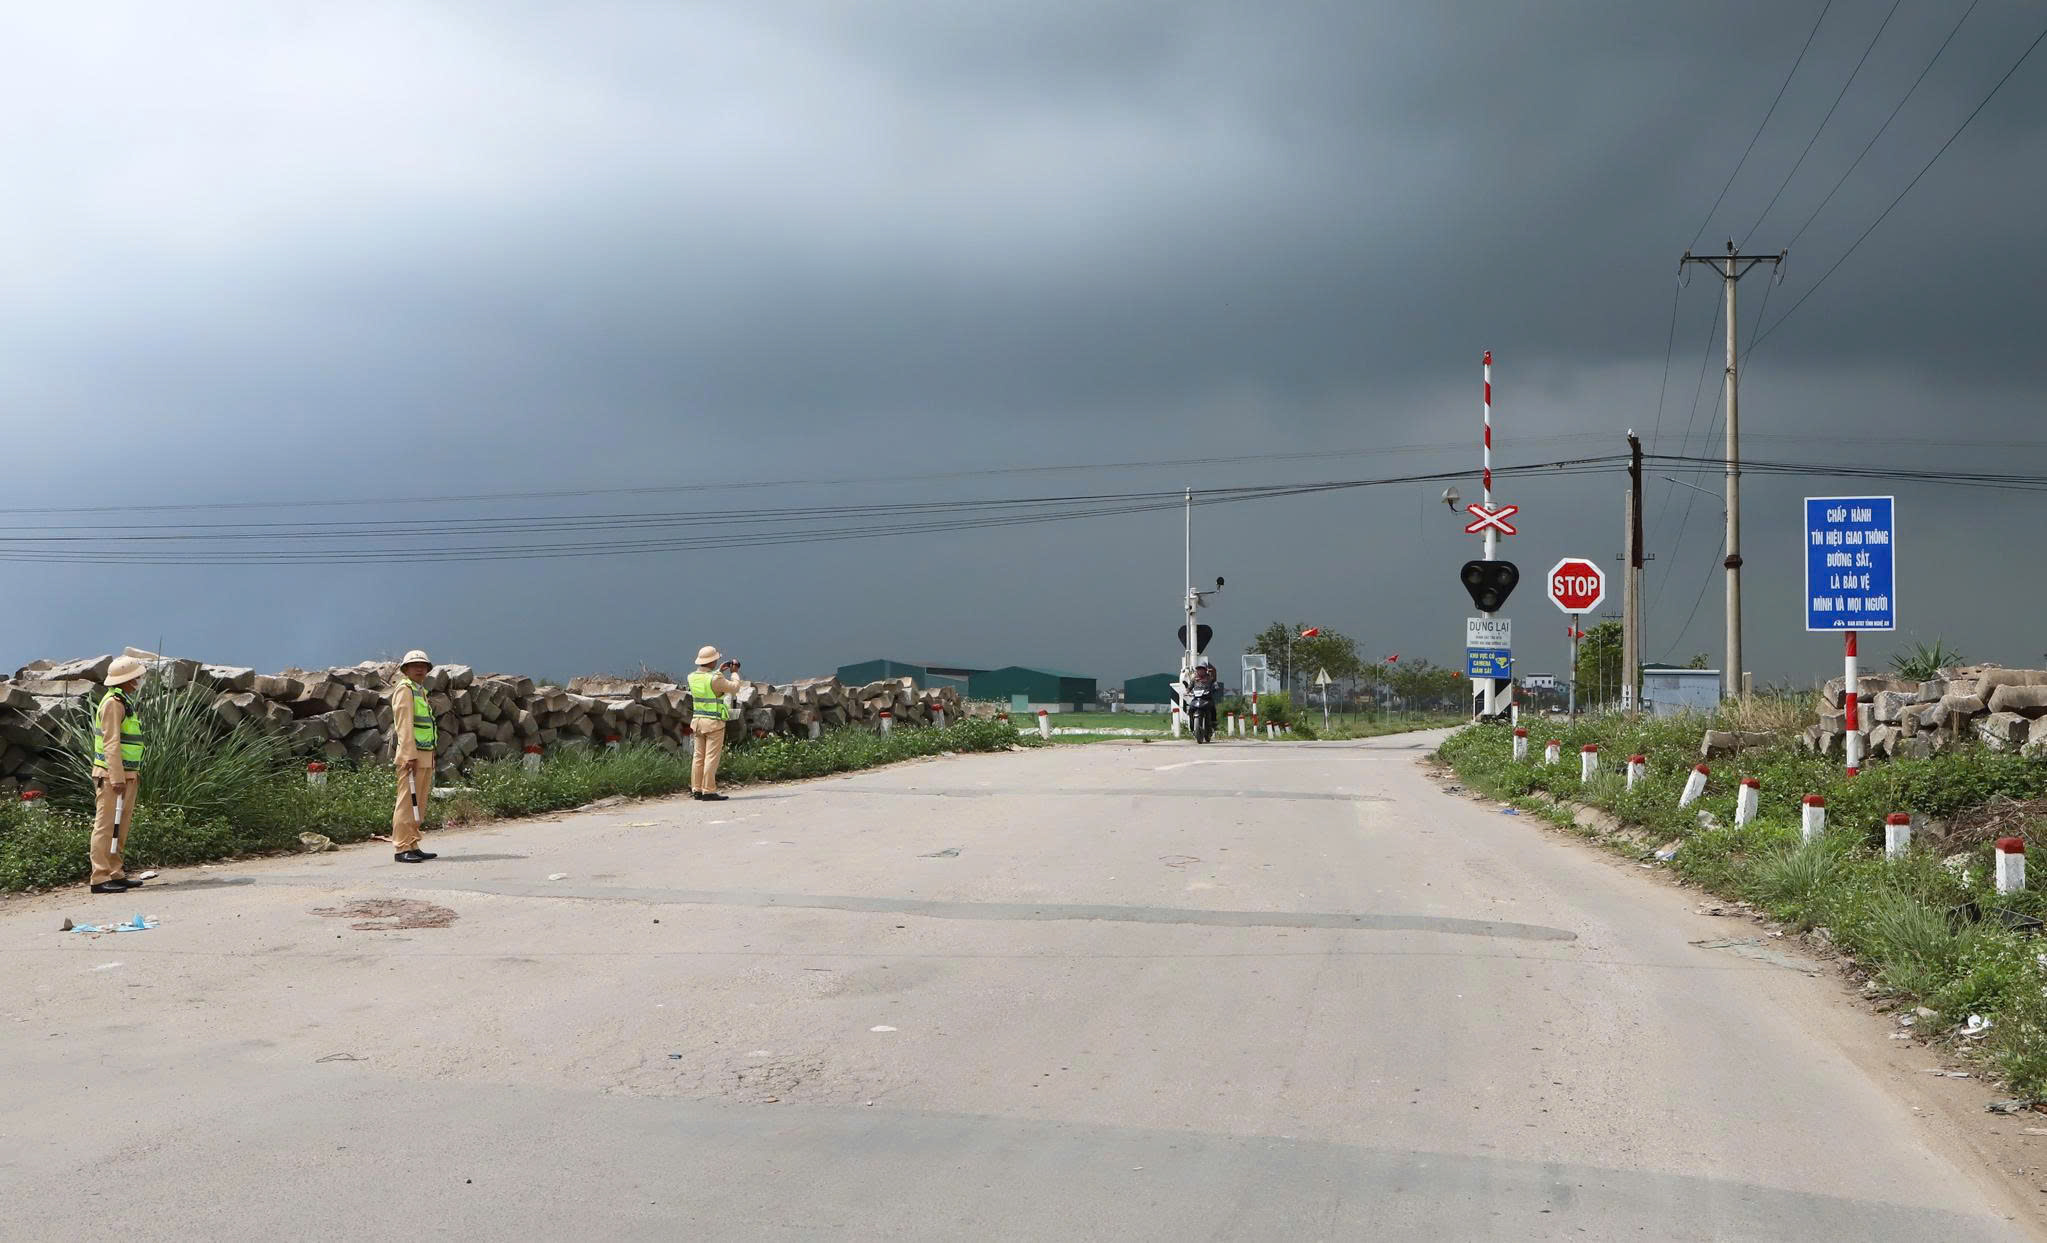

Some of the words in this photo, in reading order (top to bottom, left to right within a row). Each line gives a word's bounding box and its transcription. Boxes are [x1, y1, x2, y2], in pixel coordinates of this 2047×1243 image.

[1826, 505, 1847, 523] CHẤP
[1851, 506, 1872, 523] HÀNH
[1811, 529, 1824, 545] TÍN
[1826, 528, 1843, 547] HIỆU
[1845, 530, 1863, 545] GIAO
[1865, 528, 1889, 545] THÔNG
[1826, 550, 1852, 567] ĐƯỜNG
[1554, 576, 1598, 596] STOP
[1830, 573, 1840, 589] LÀ
[1843, 571, 1858, 589] BẢO
[1860, 572, 1870, 591] VỆ
[1813, 595, 1833, 611] MÌNH
[1835, 595, 1845, 611] VÀ
[1847, 597, 1862, 613] MỌI
[1865, 594, 1888, 611] NGƯỜI
